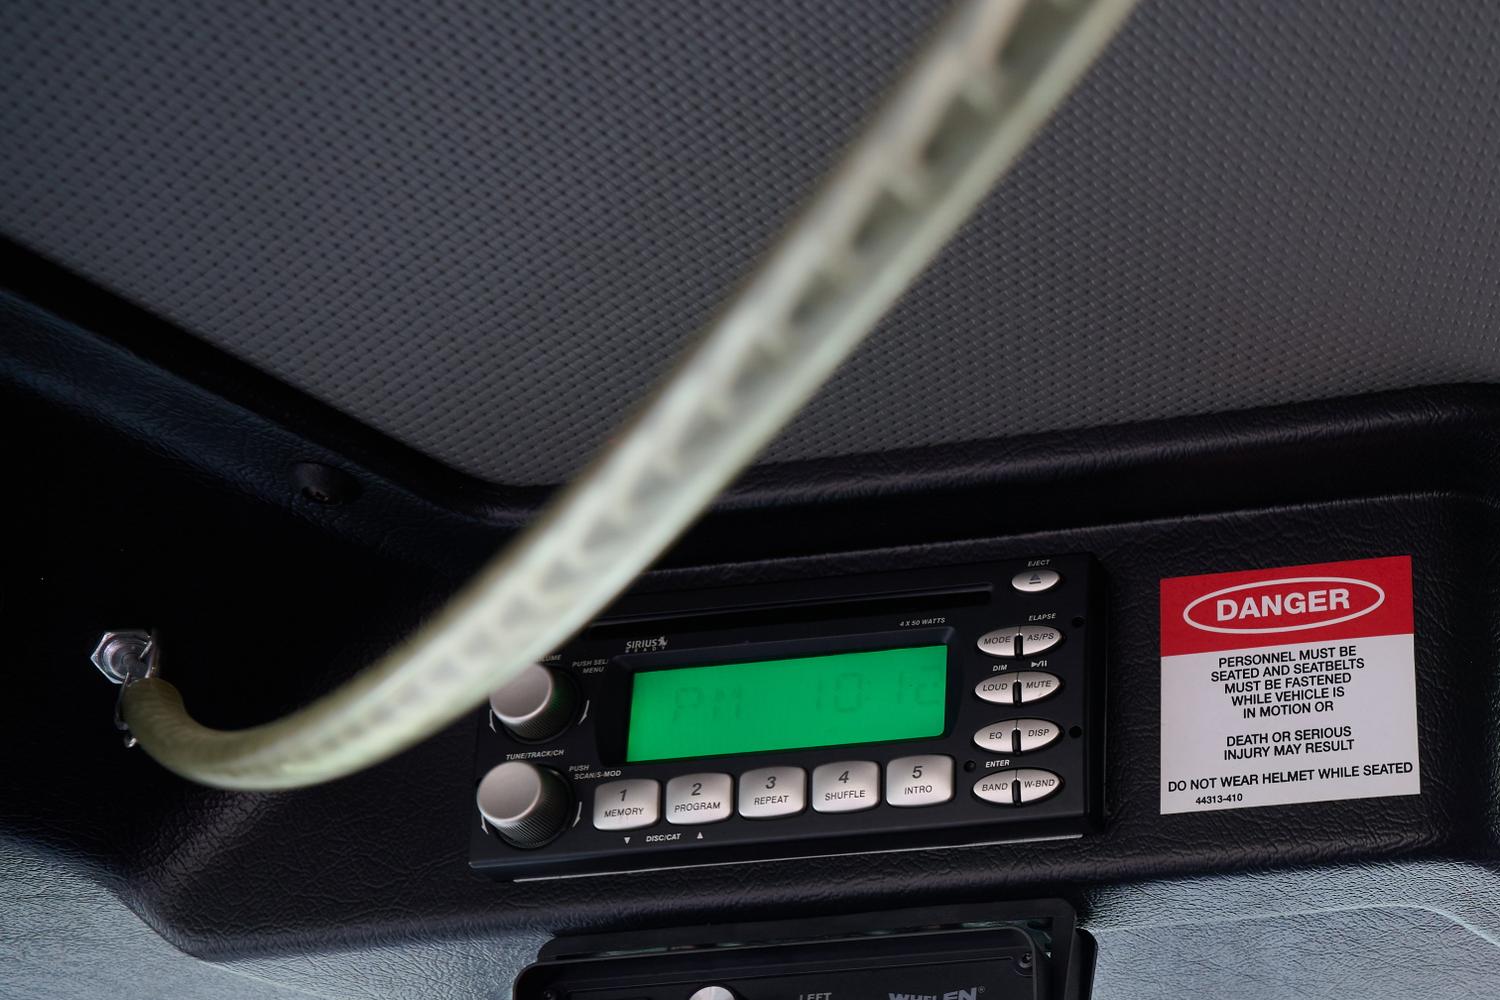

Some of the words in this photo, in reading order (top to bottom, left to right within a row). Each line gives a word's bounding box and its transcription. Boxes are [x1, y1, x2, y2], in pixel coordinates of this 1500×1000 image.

[1216, 588, 1350, 622] DANGER
[922, 617, 946, 625] WATTS
[1028, 613, 1057, 622] ELAPSE
[983, 636, 1011, 645] MODE
[1027, 632, 1055, 642] AS/PS
[626, 638, 658, 649] SIRIUS
[1218, 652, 1296, 668] PERSONNEL
[1299, 648, 1336, 661] MUST
[1339, 646, 1357, 657] BE
[572, 660, 592, 668] PUSH
[992, 664, 1008, 672] DIM
[583, 666, 605, 674] MENU
[1211, 667, 1260, 682] SEATED
[1263, 665, 1290, 678] AND
[1293, 658, 1365, 674] SEATBELTS
[983, 683, 1008, 692] LOUD
[1025, 680, 1052, 689] MUTE
[1224, 681, 1261, 694] MUST
[1264, 678, 1282, 690] BE
[1285, 672, 1351, 688] FASTENED
[1231, 693, 1272, 706] WHILE
[1275, 688, 1329, 702] VEHICLE
[1332, 686, 1345, 698] IS
[1243, 708, 1256, 719] IN
[1259, 703, 1311, 717] MOTION
[1314, 701, 1333, 713] OR
[989, 732, 1003, 740] EQ
[1028, 729, 1049, 737] DISP
[1226, 733, 1268, 747] DEATH
[1272, 732, 1291, 743] OR
[1294, 726, 1352, 741] SERIOUS
[506, 749, 565, 761] TUNE/TRACK/CH
[1224, 747, 1270, 760] INJURY
[1274, 744, 1301, 757] MAY
[1305, 740, 1355, 754] RESULT
[985, 760, 1010, 768] ENTER
[838, 770, 850, 784] 4
[912, 765, 923, 779] 5
[1168, 780, 1187, 792] DO
[1190, 778, 1217, 790] NOT
[1220, 774, 1259, 787] WEAR
[1262, 770, 1314, 784] HELMET
[1318, 766, 1359, 780] WHILE
[1363, 762, 1413, 776] SEATED
[765, 776, 777, 789] 3
[981, 783, 1008, 792] BAND
[1024, 779, 1055, 788] W-BND
[691, 782, 702, 796] 2
[904, 785, 933, 795] INTRO
[618, 789, 628, 802] 1
[754, 795, 789, 805] REPEAT
[824, 790, 866, 801] SHUFFLE
[1195, 793, 1243, 805] 44313-410
[603, 807, 645, 818] MEMORY
[674, 801, 721, 813] PROGRAM
[645, 833, 682, 842] DISC/CAT
